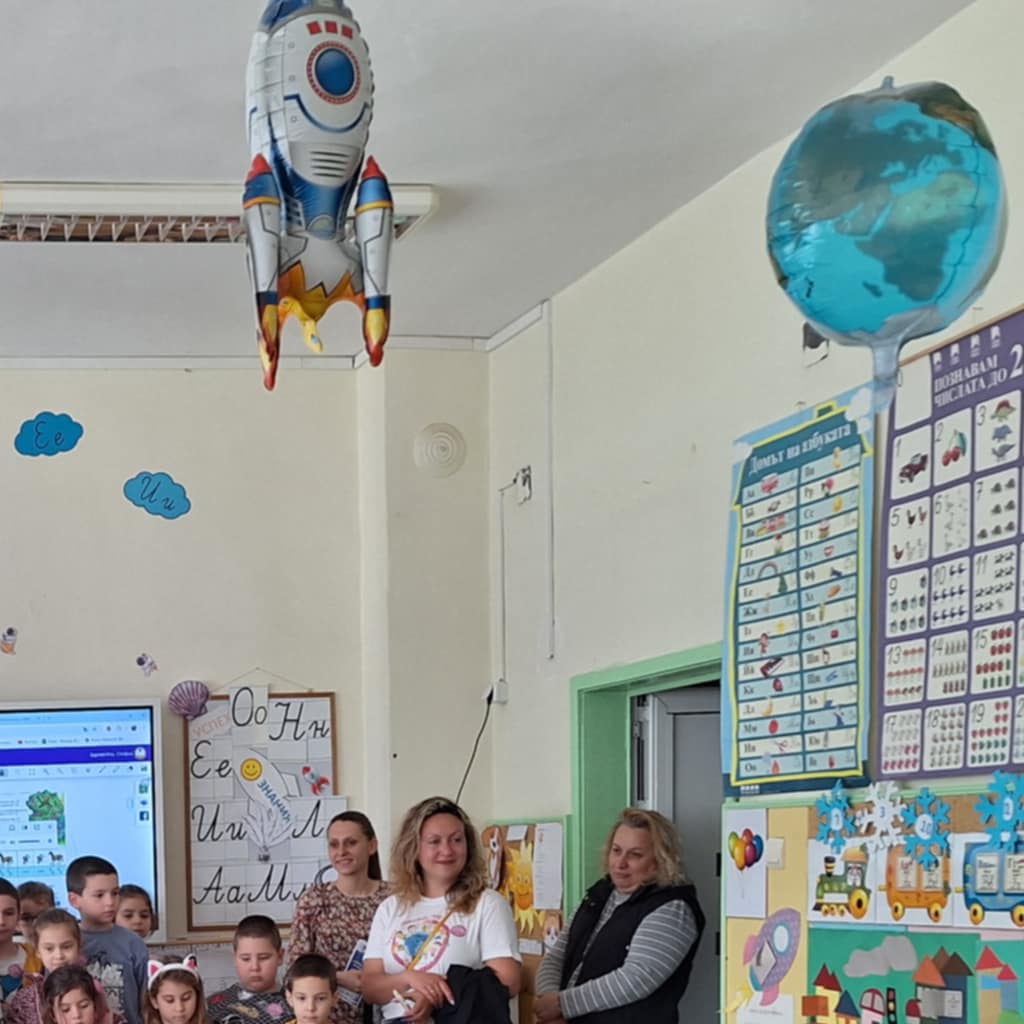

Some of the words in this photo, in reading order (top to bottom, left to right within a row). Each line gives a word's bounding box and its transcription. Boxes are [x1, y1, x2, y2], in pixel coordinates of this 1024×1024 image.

[192, 714, 232, 738] УСПЕ
[232, 686, 268, 727] Оо
[269, 701, 330, 741] Нн
[190, 740, 232, 779] Ее
[191, 804, 247, 841] Ии
